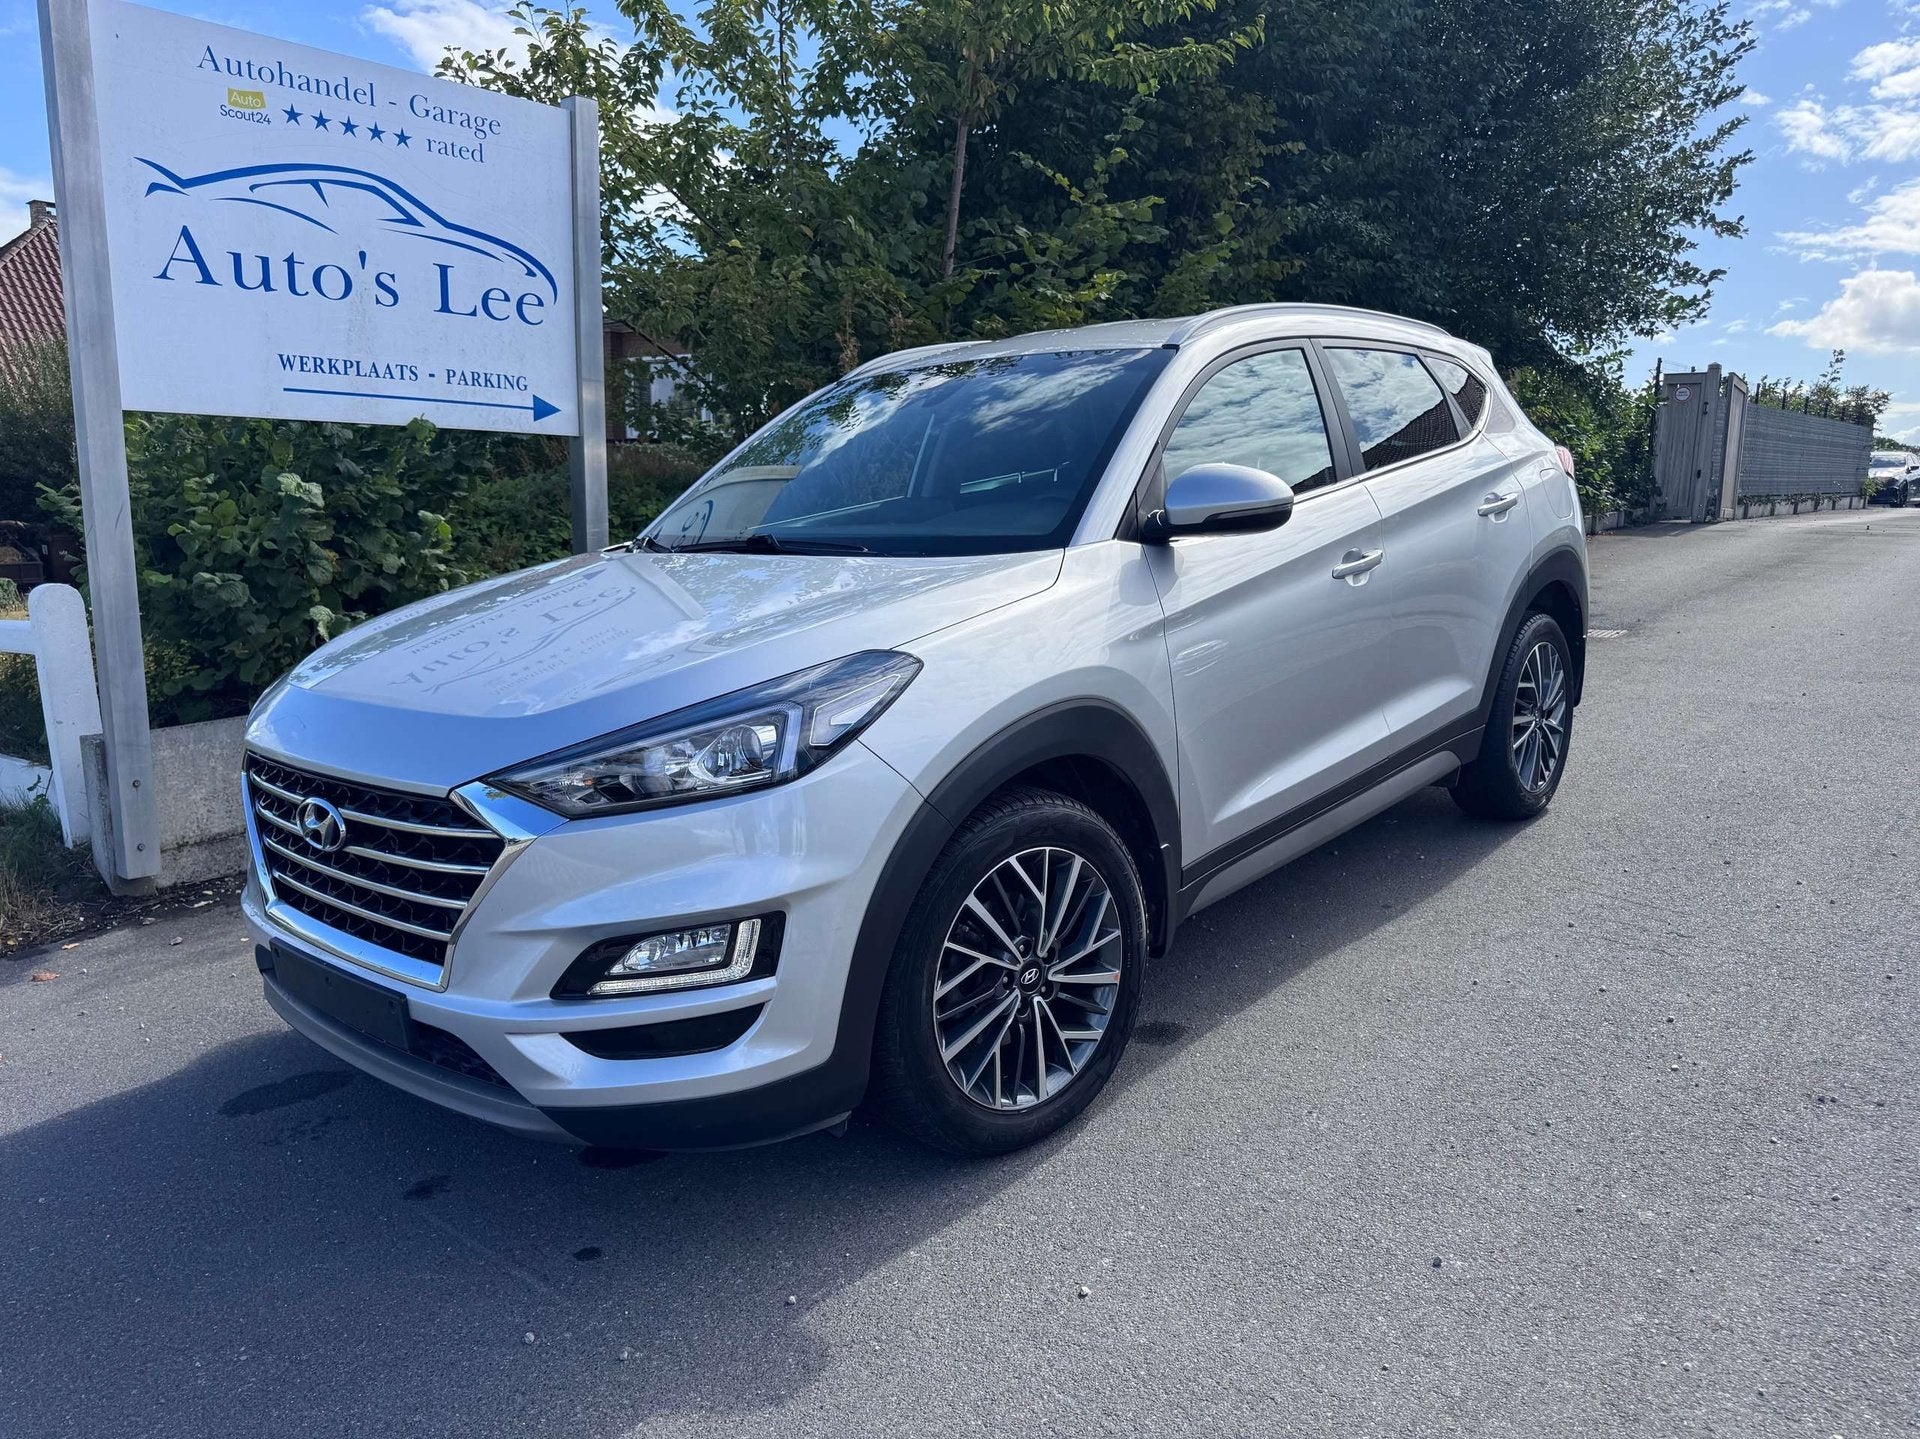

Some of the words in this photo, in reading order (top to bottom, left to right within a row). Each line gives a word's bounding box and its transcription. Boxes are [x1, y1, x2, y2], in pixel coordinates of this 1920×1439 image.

[196, 44, 377, 108] Autohandel
[409, 94, 502, 141] Garage
[230, 91, 261, 108] Auto
[219, 103, 272, 126] Scout24
[425, 138, 485, 164] rated
[152, 224, 400, 308] Auto's
[432, 262, 545, 326] Lee
[276, 353, 419, 382] WERKPLAATS
[445, 368, 529, 392] PARKING
